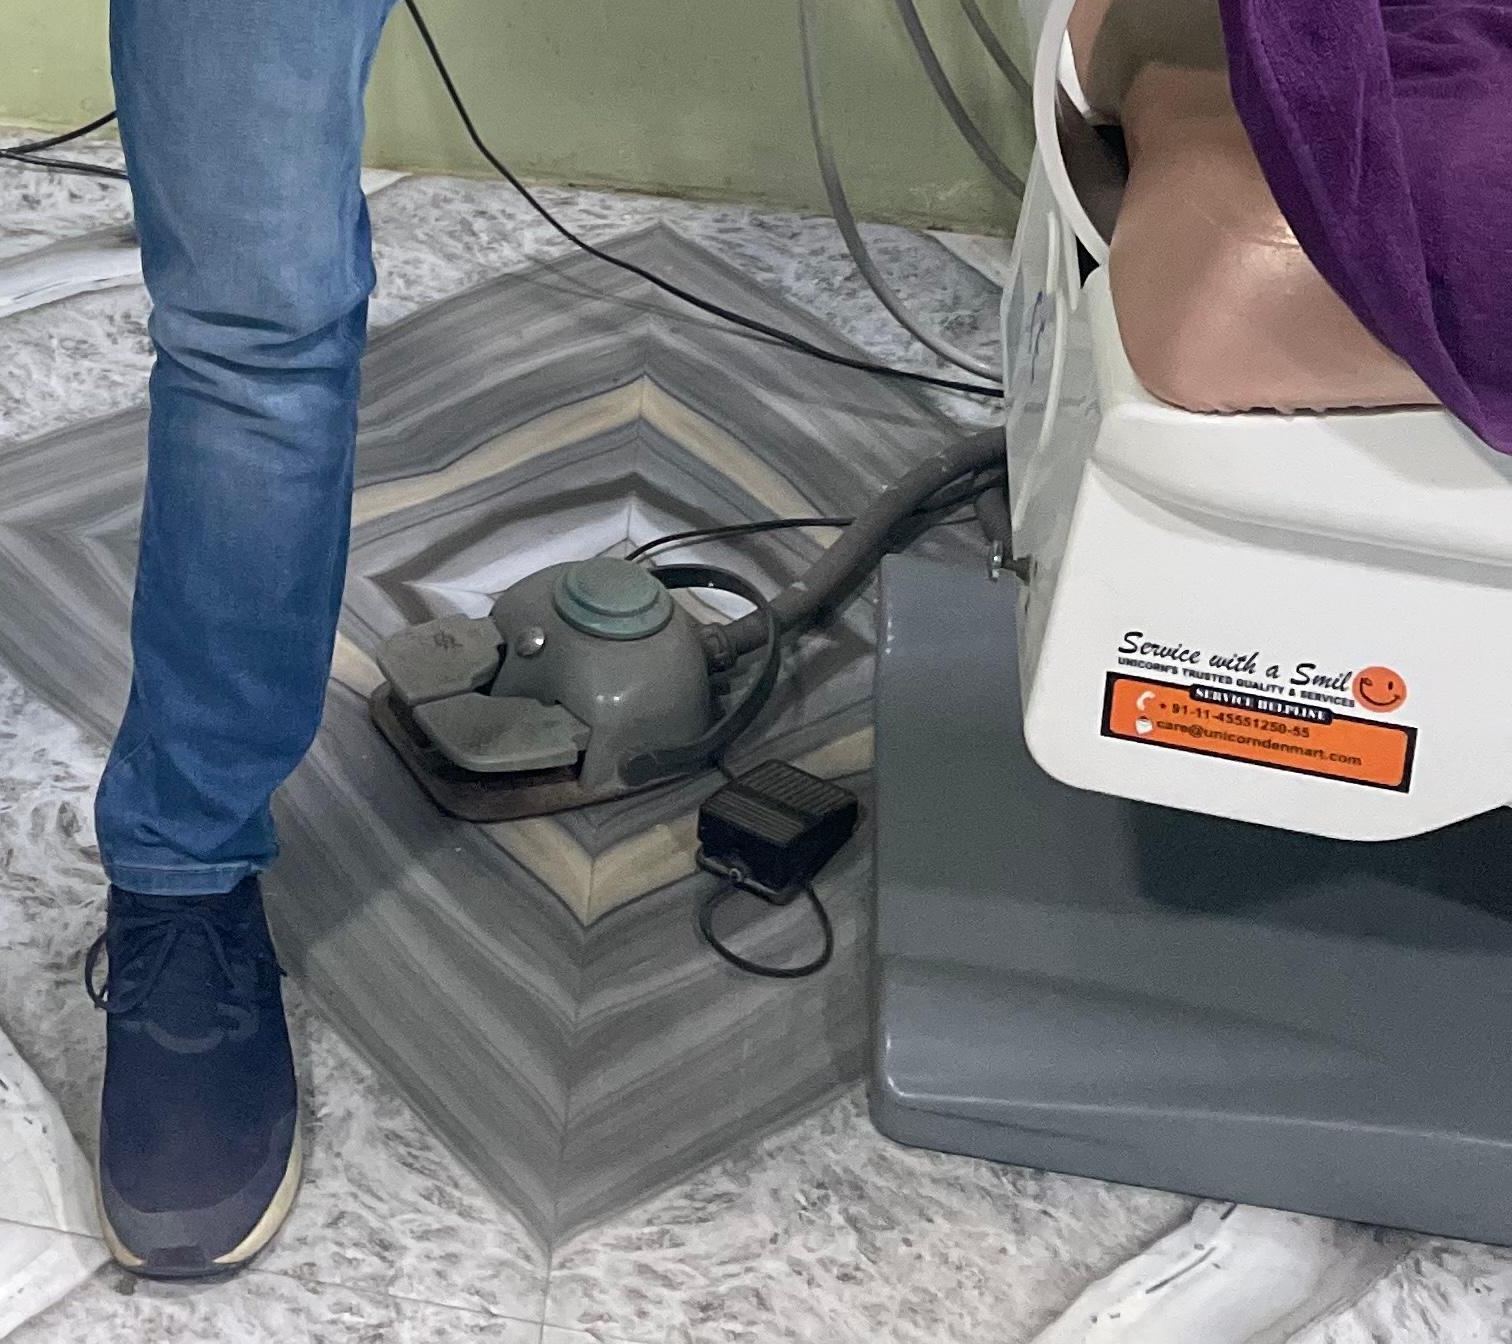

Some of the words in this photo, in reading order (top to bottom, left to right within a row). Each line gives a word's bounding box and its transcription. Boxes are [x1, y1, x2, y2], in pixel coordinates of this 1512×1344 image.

[1117, 630, 1201, 665] Service
[1208, 650, 1260, 675] with
[1265, 664, 1280, 680] a
[1182, 667, 1234, 685] TRUSTED
[1236, 678, 1285, 695] QUALITY
